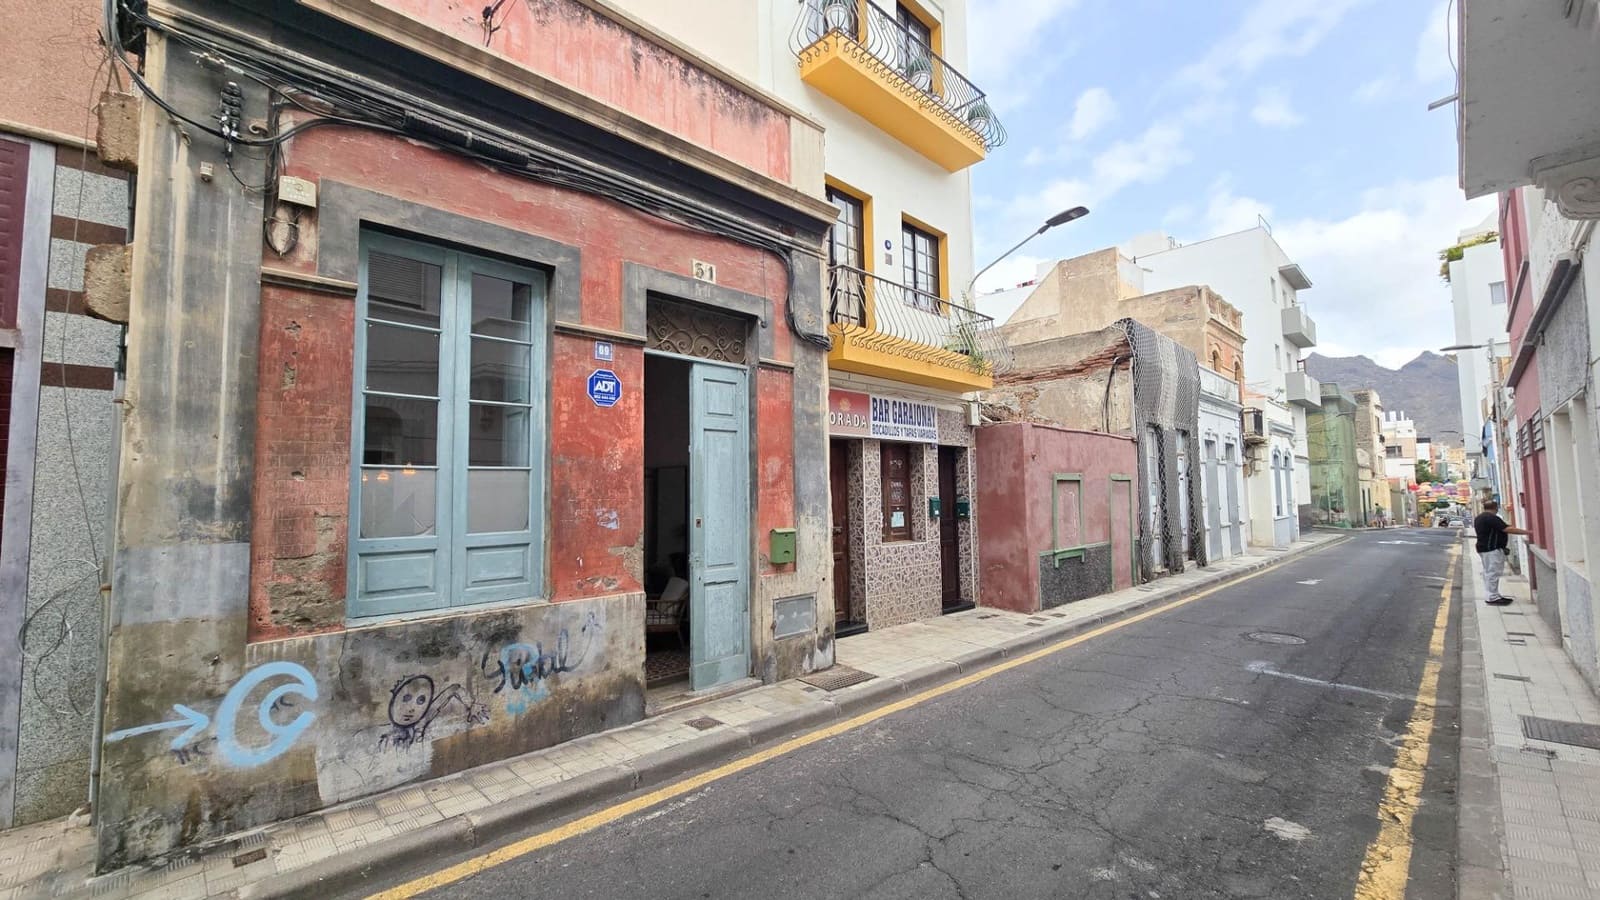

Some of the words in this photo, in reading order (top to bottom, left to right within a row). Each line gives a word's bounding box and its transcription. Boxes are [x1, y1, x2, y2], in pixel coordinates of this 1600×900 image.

[594, 380, 616, 393] ADT
[872, 397, 890, 423] BAR
[829, 411, 868, 428] ORADA
[872, 423, 900, 437] BOCADILLOS
